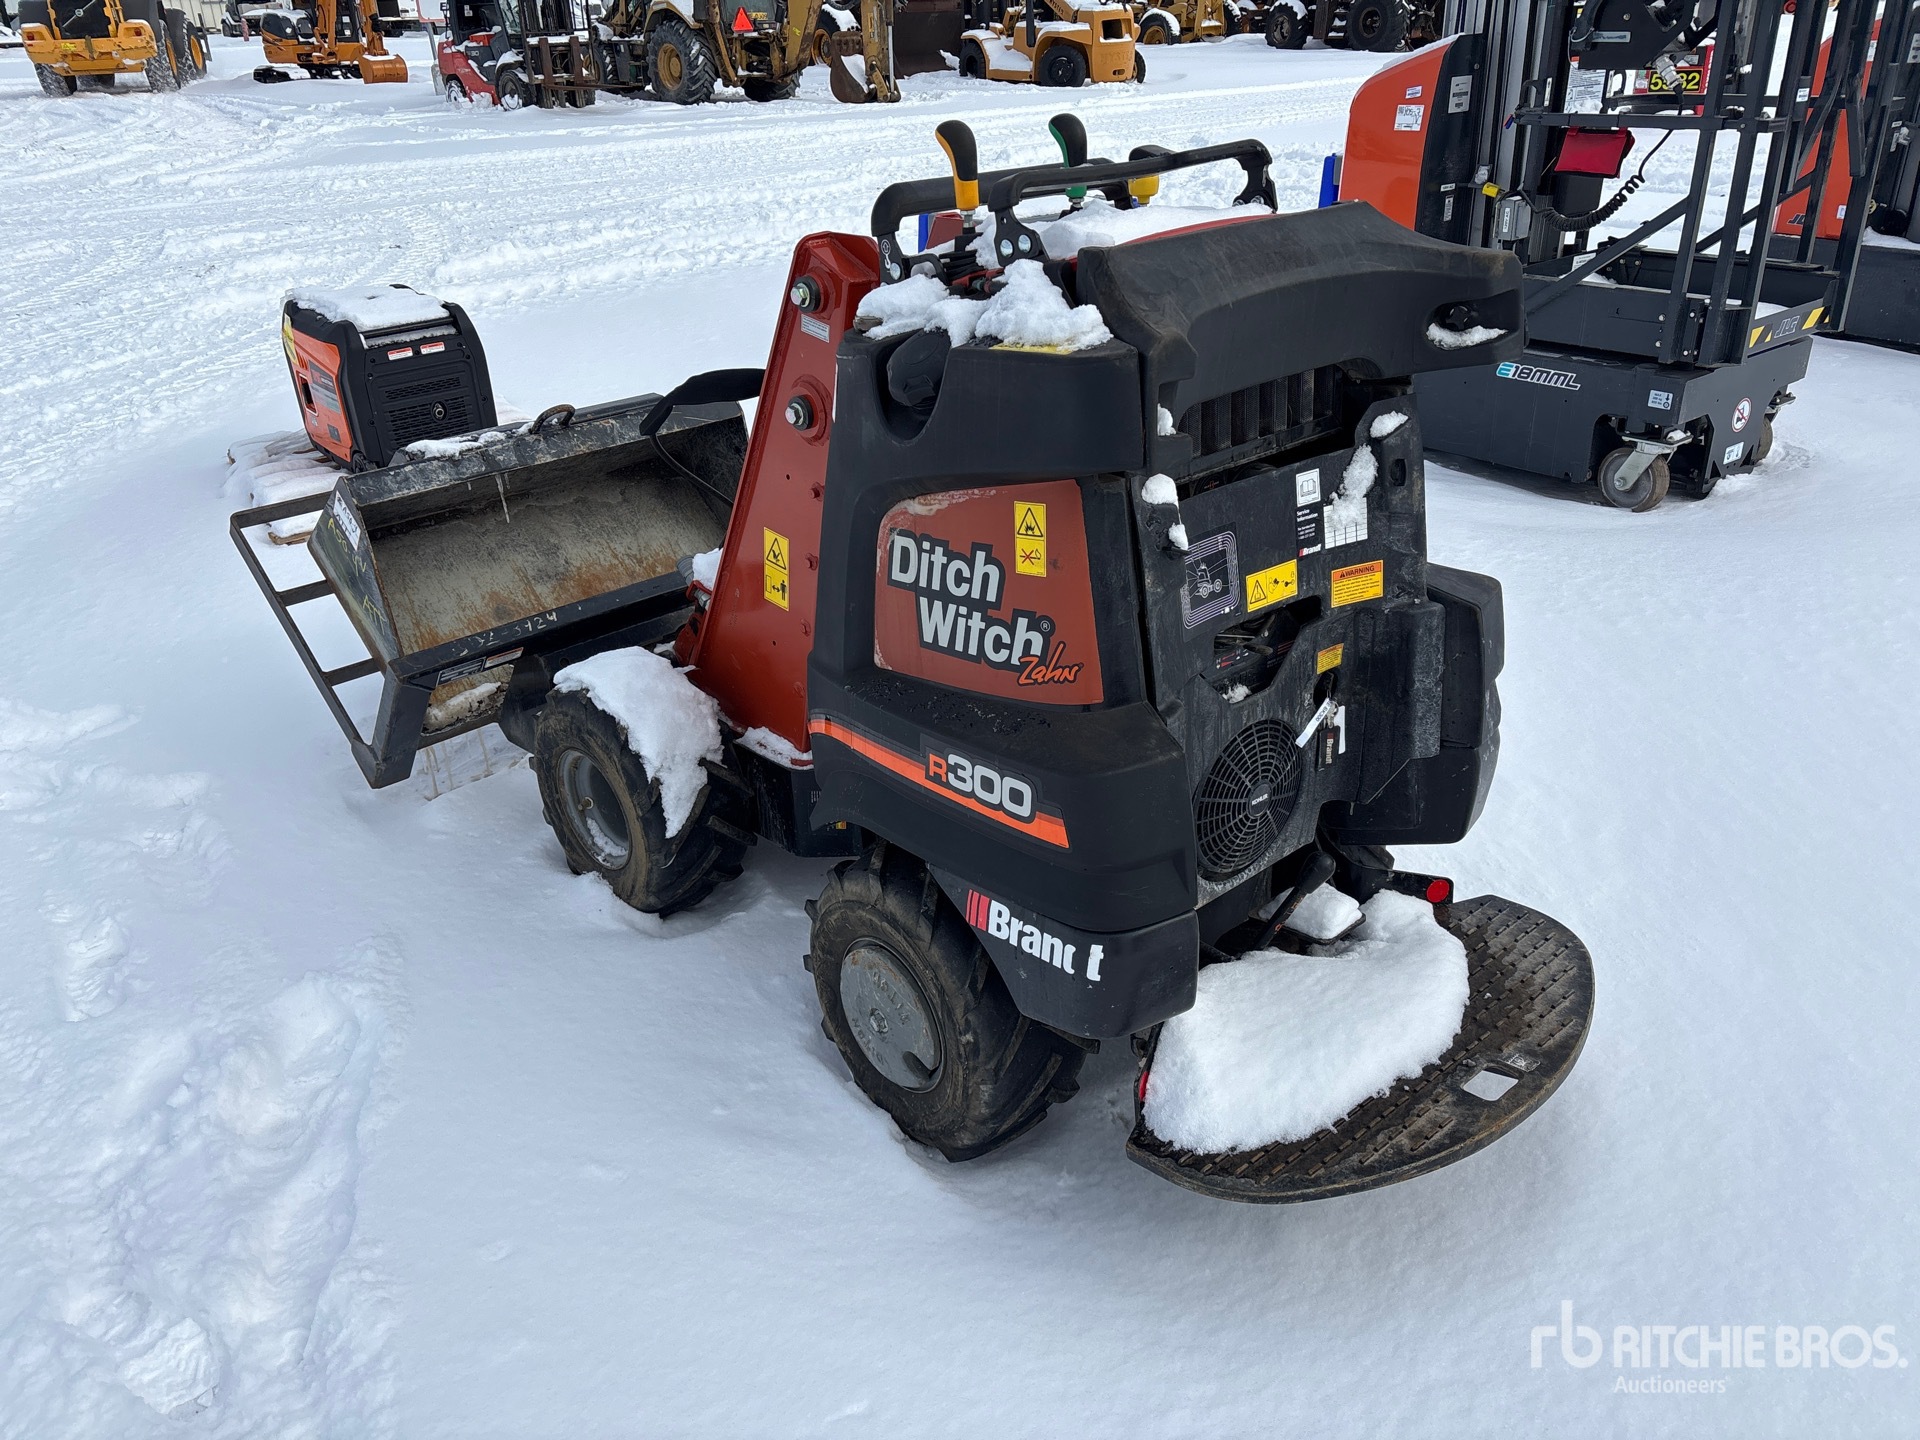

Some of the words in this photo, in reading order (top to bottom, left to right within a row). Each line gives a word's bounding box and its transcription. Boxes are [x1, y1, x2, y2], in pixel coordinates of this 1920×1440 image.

[1496, 362, 1580, 390] E18MML
[891, 534, 1000, 603] Ditch
[1345, 565, 1375, 576] WARNING
[1018, 641, 1087, 686] Zahn
[929, 753, 1032, 818] R300
